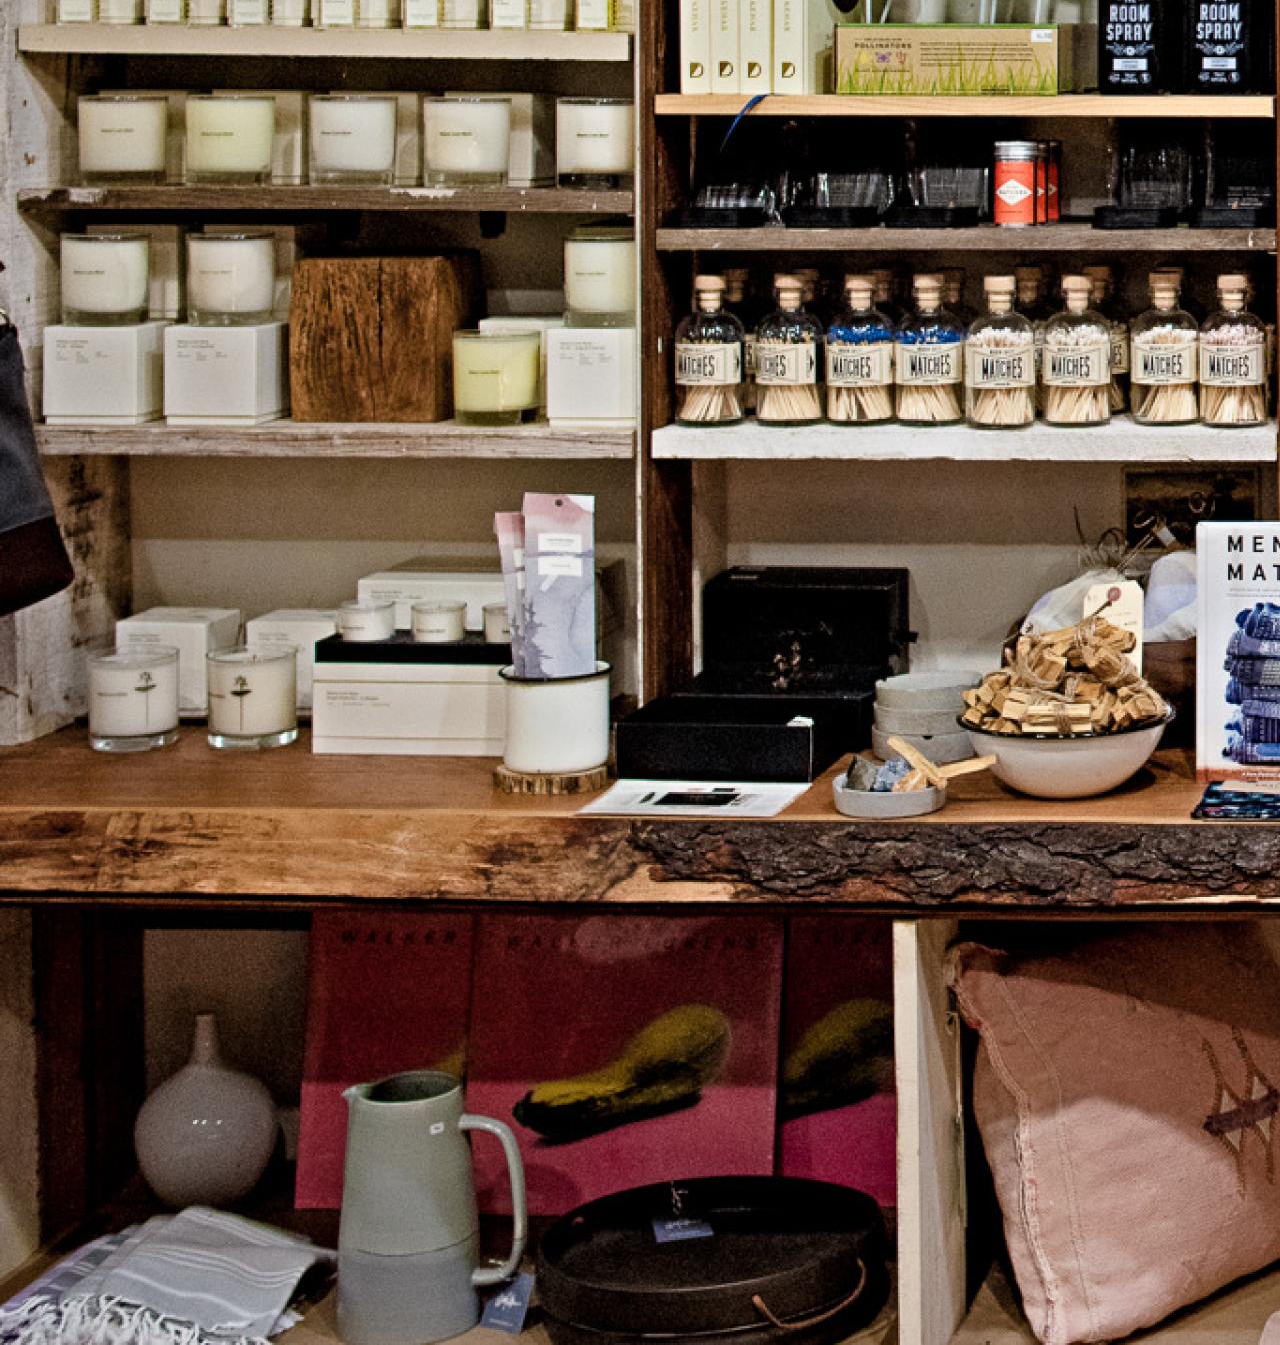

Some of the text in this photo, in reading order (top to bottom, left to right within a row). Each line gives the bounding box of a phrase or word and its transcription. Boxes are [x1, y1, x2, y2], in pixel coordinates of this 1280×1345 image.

[1109, 4, 1150, 23] ROOM
[1200, 3, 1240, 21] ROOM
[1106, 22, 1154, 42] SPRAY
[1196, 21, 1244, 40] SPRAY
[832, 355, 872, 377] MATCHES
[911, 354, 951, 376] MATCHES
[981, 356, 1023, 380] MATCHES
[1051, 355, 1091, 378] MATCHES
[1144, 354, 1183, 376] MATCHES
[1208, 354, 1250, 378] MATCHES
[339, 928, 458, 945] WALKER
